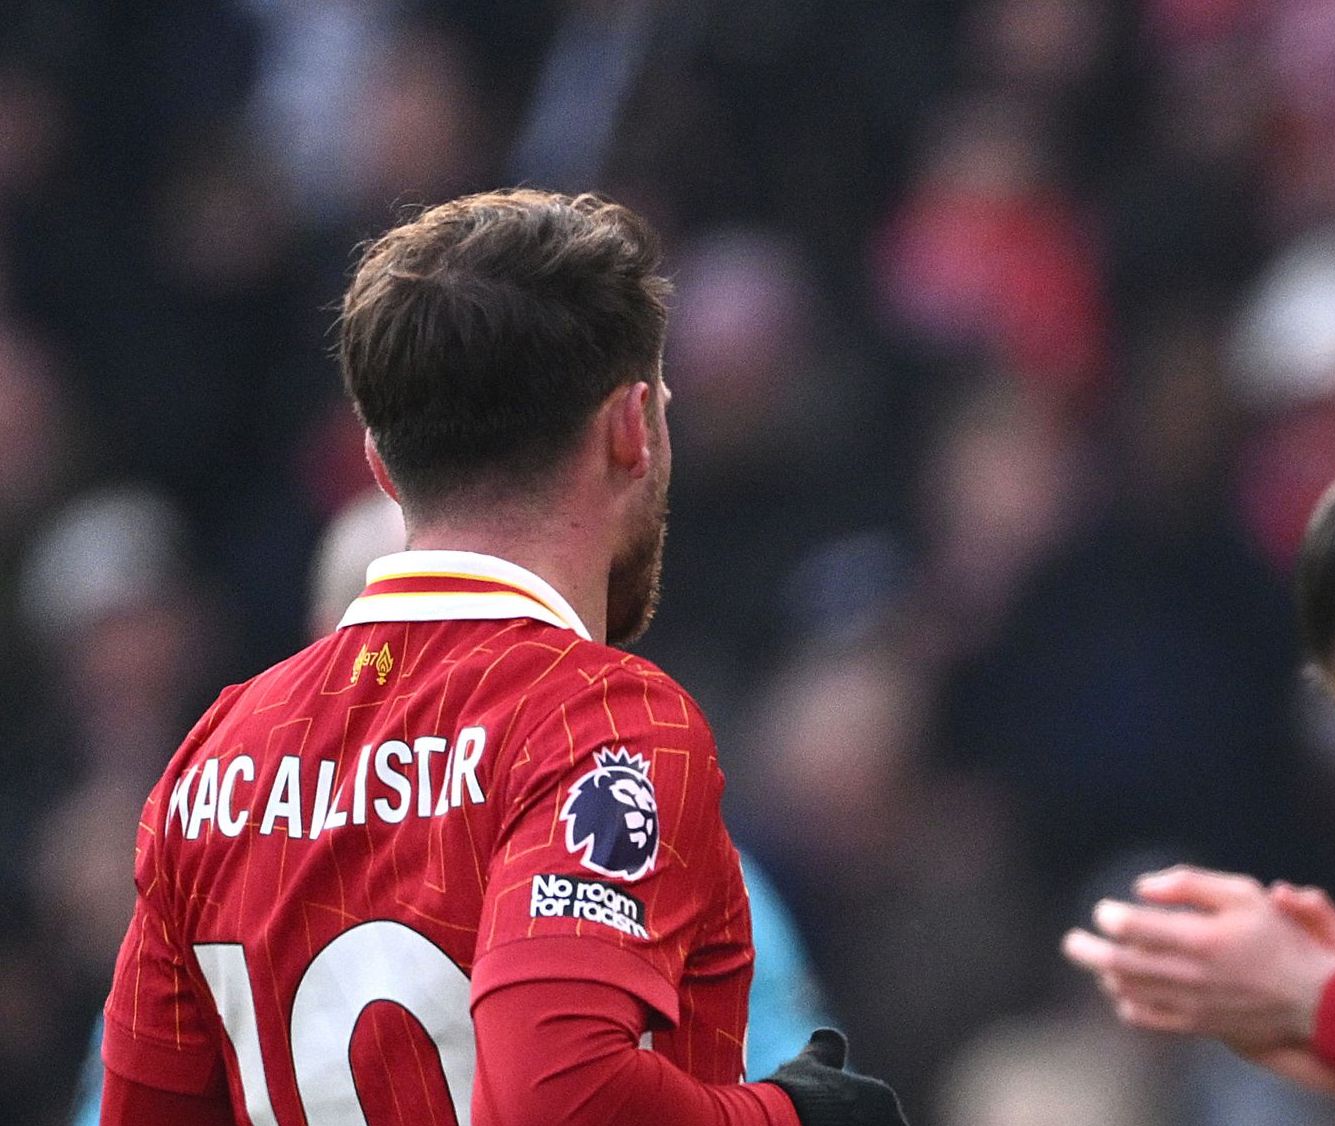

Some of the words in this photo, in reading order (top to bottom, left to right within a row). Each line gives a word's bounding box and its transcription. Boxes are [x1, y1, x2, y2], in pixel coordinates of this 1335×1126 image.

[530, 894, 571, 918] for
[573, 901, 650, 941] racism
[531, 874, 573, 898] No
[576, 882, 638, 920] room
